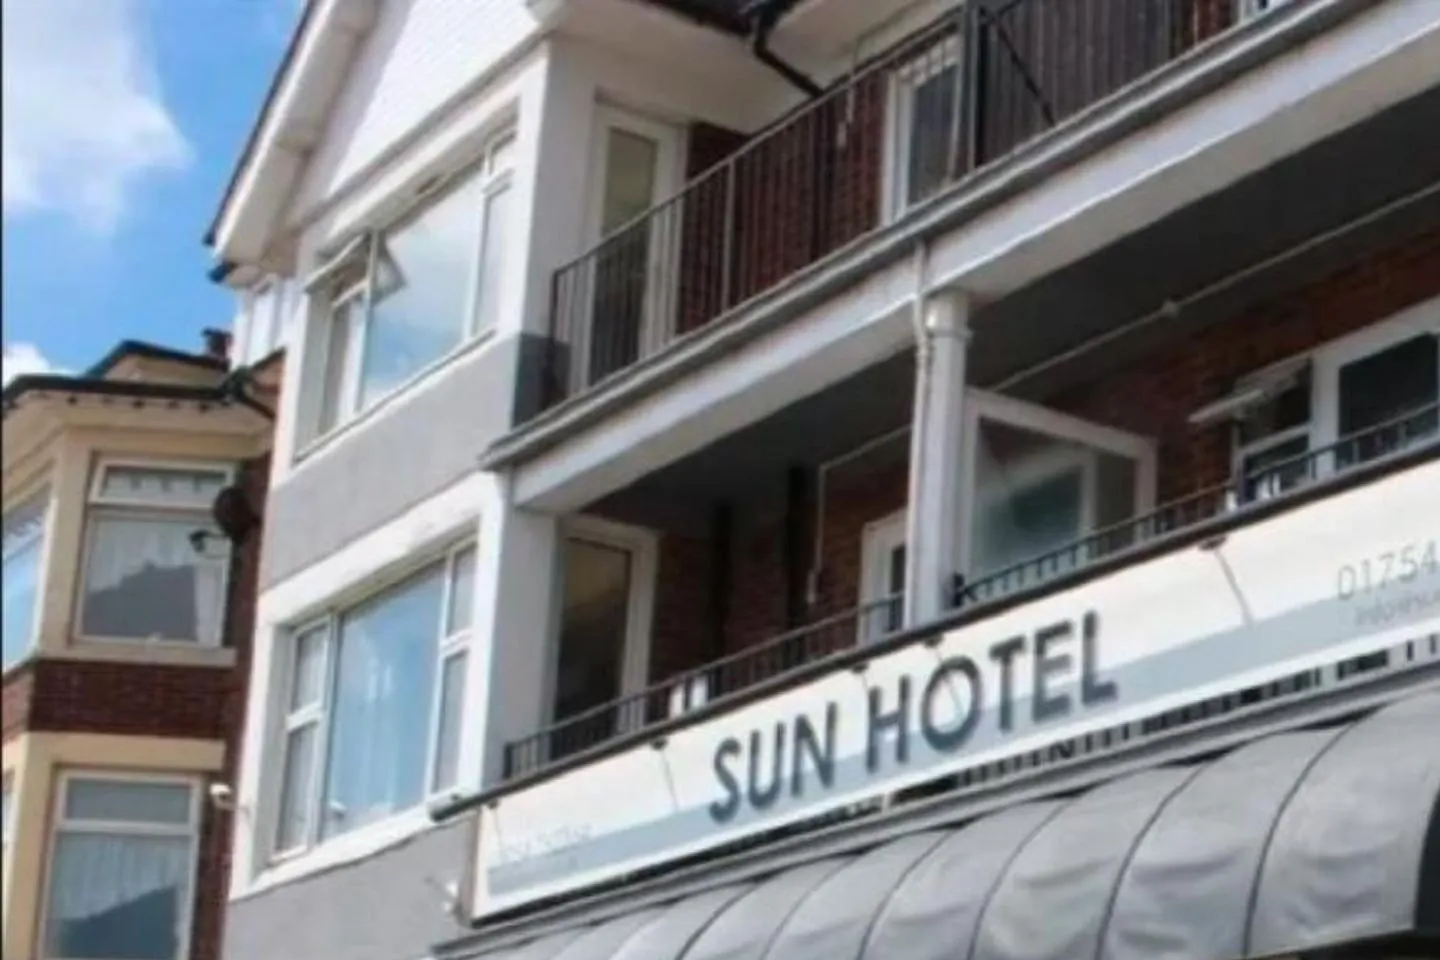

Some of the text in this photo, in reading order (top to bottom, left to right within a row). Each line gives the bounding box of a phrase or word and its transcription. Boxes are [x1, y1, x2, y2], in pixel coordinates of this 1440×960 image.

[1336, 540, 1437, 600] 01754
[708, 610, 1118, 822] SUN HOTEL
